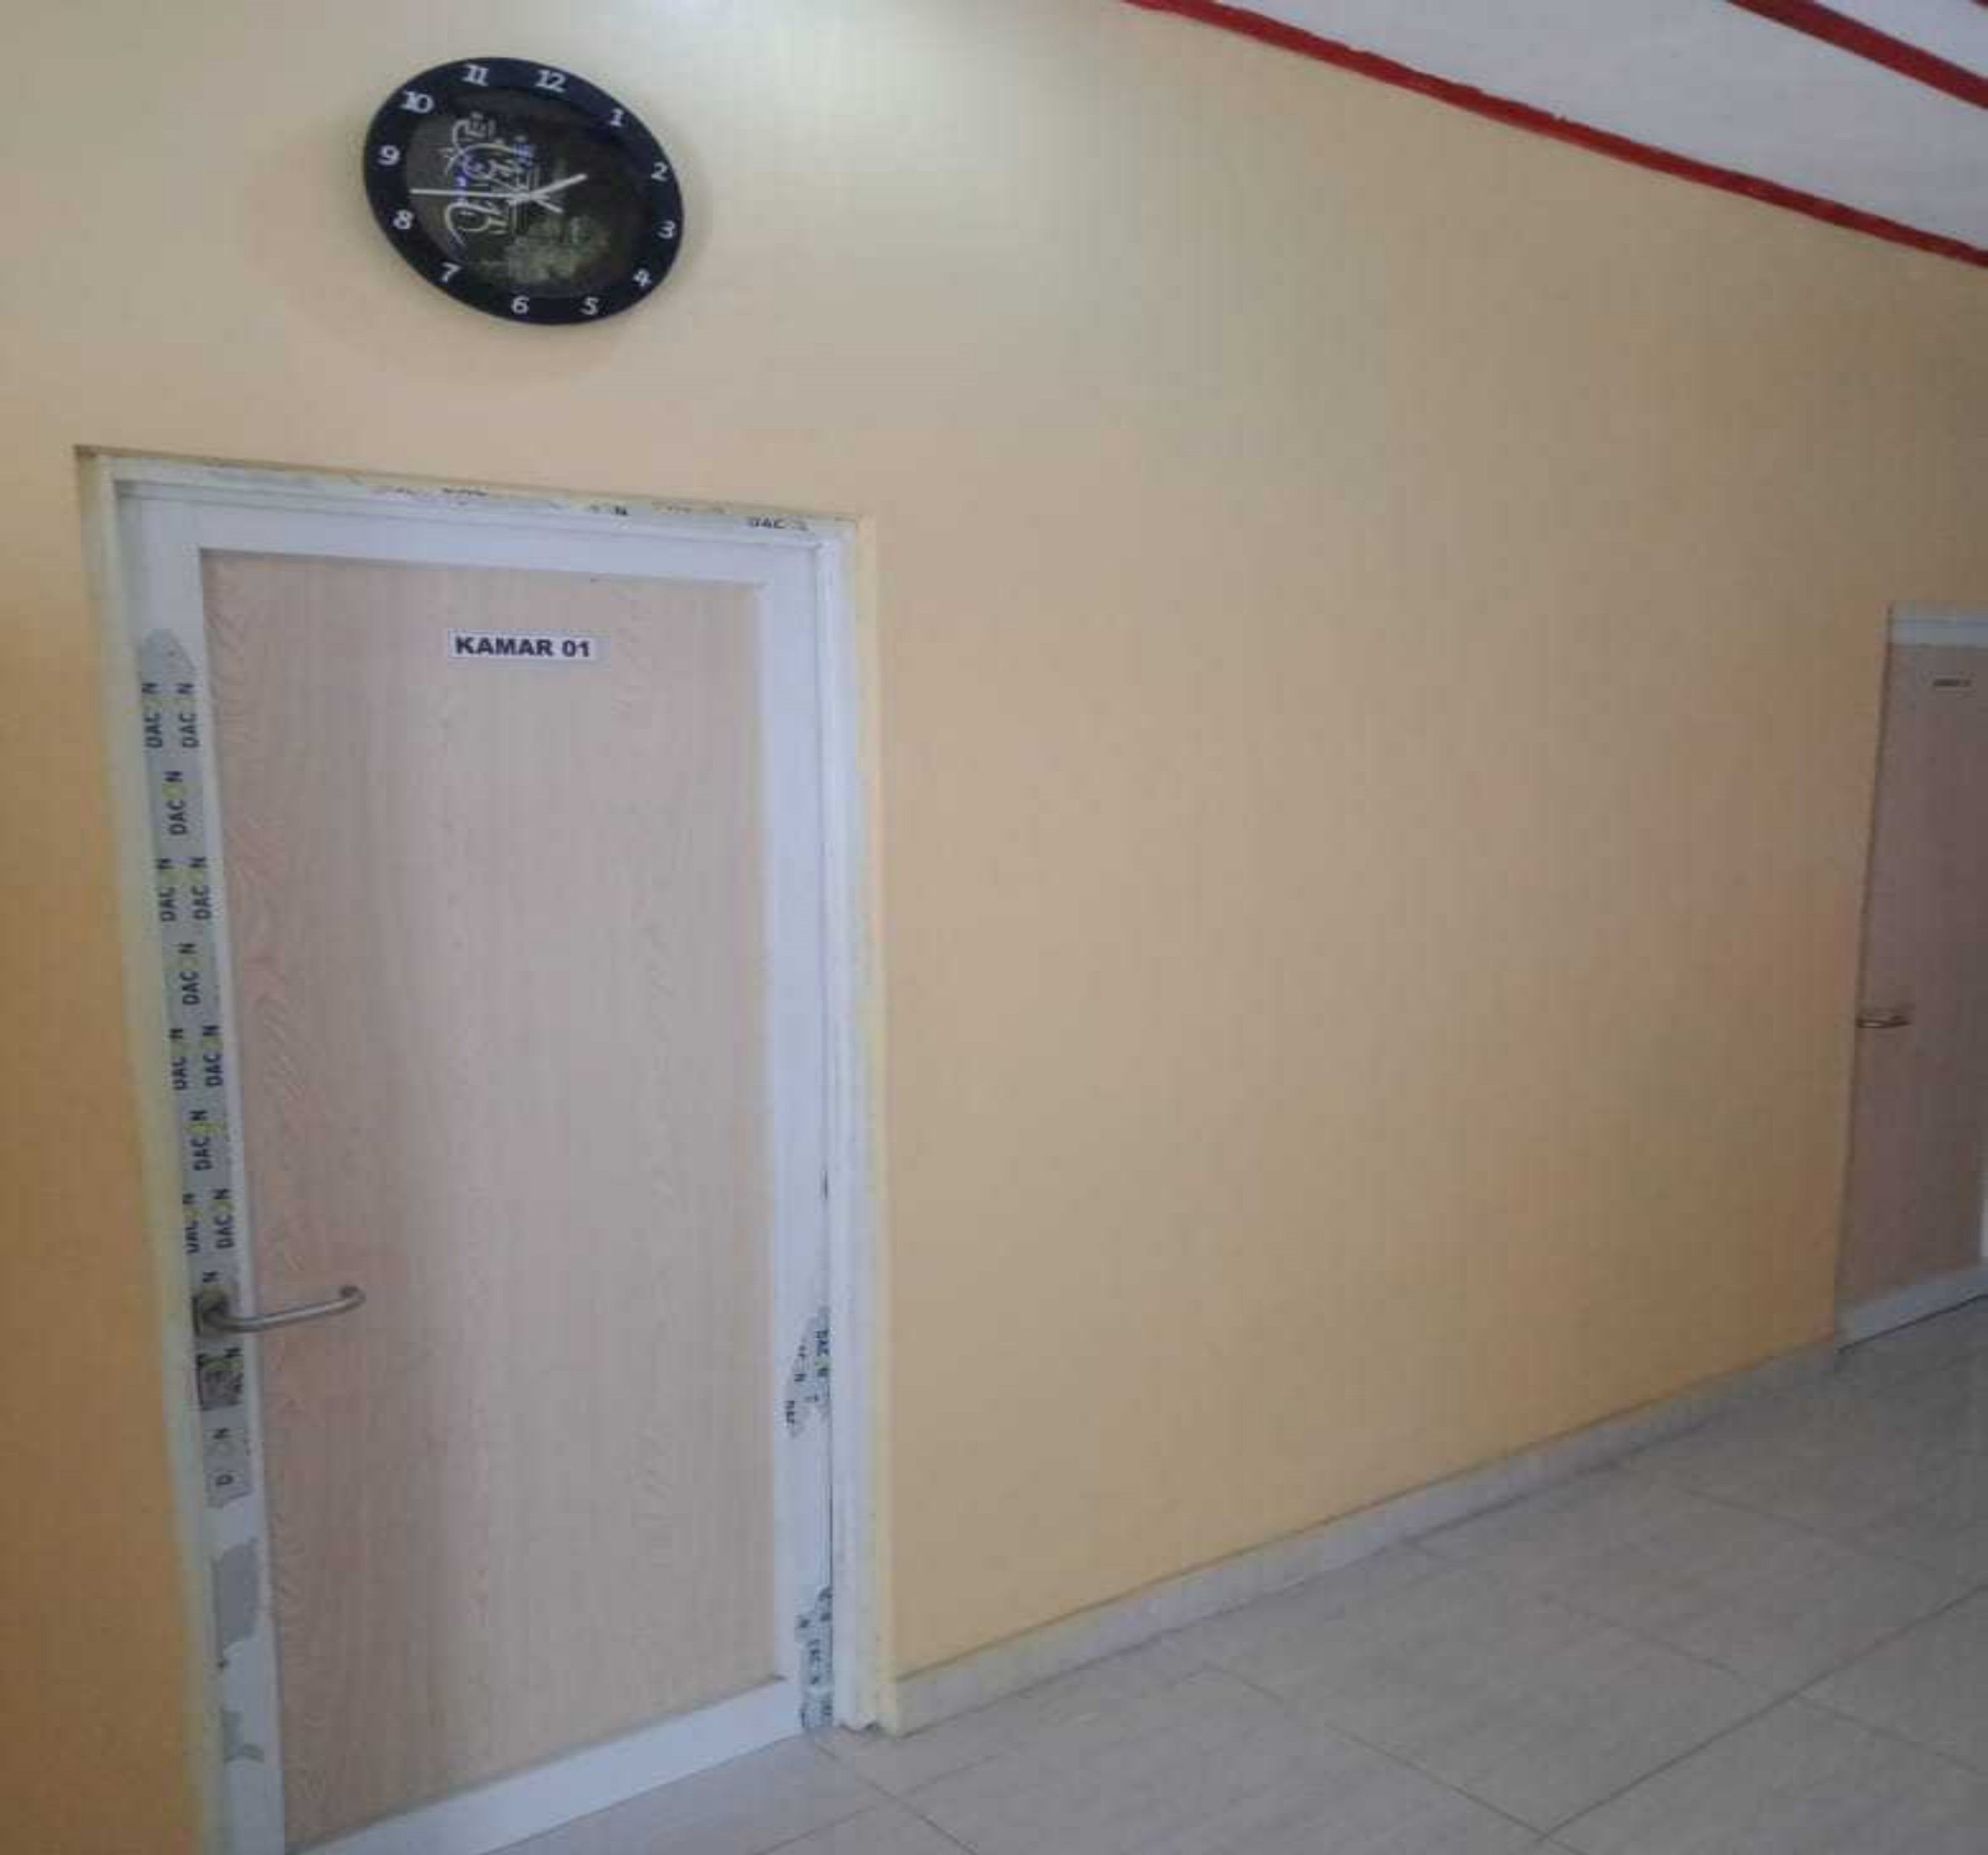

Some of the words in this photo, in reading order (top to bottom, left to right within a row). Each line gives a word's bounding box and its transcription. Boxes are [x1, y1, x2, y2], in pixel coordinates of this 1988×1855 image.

[464, 65, 488, 85] 11
[536, 69, 566, 93] 12
[402, 91, 435, 114] 10
[609, 109, 625, 127] 1
[377, 146, 400, 166] 9
[651, 164, 669, 181] 2
[393, 210, 414, 230] 8
[659, 223, 675, 238] 3
[441, 264, 460, 283] 7
[633, 268, 652, 288] 4
[511, 295, 529, 314] 6
[580, 297, 598, 315] 5
[455, 636, 555, 657] KAMAR
[562, 639, 590, 657] 01
